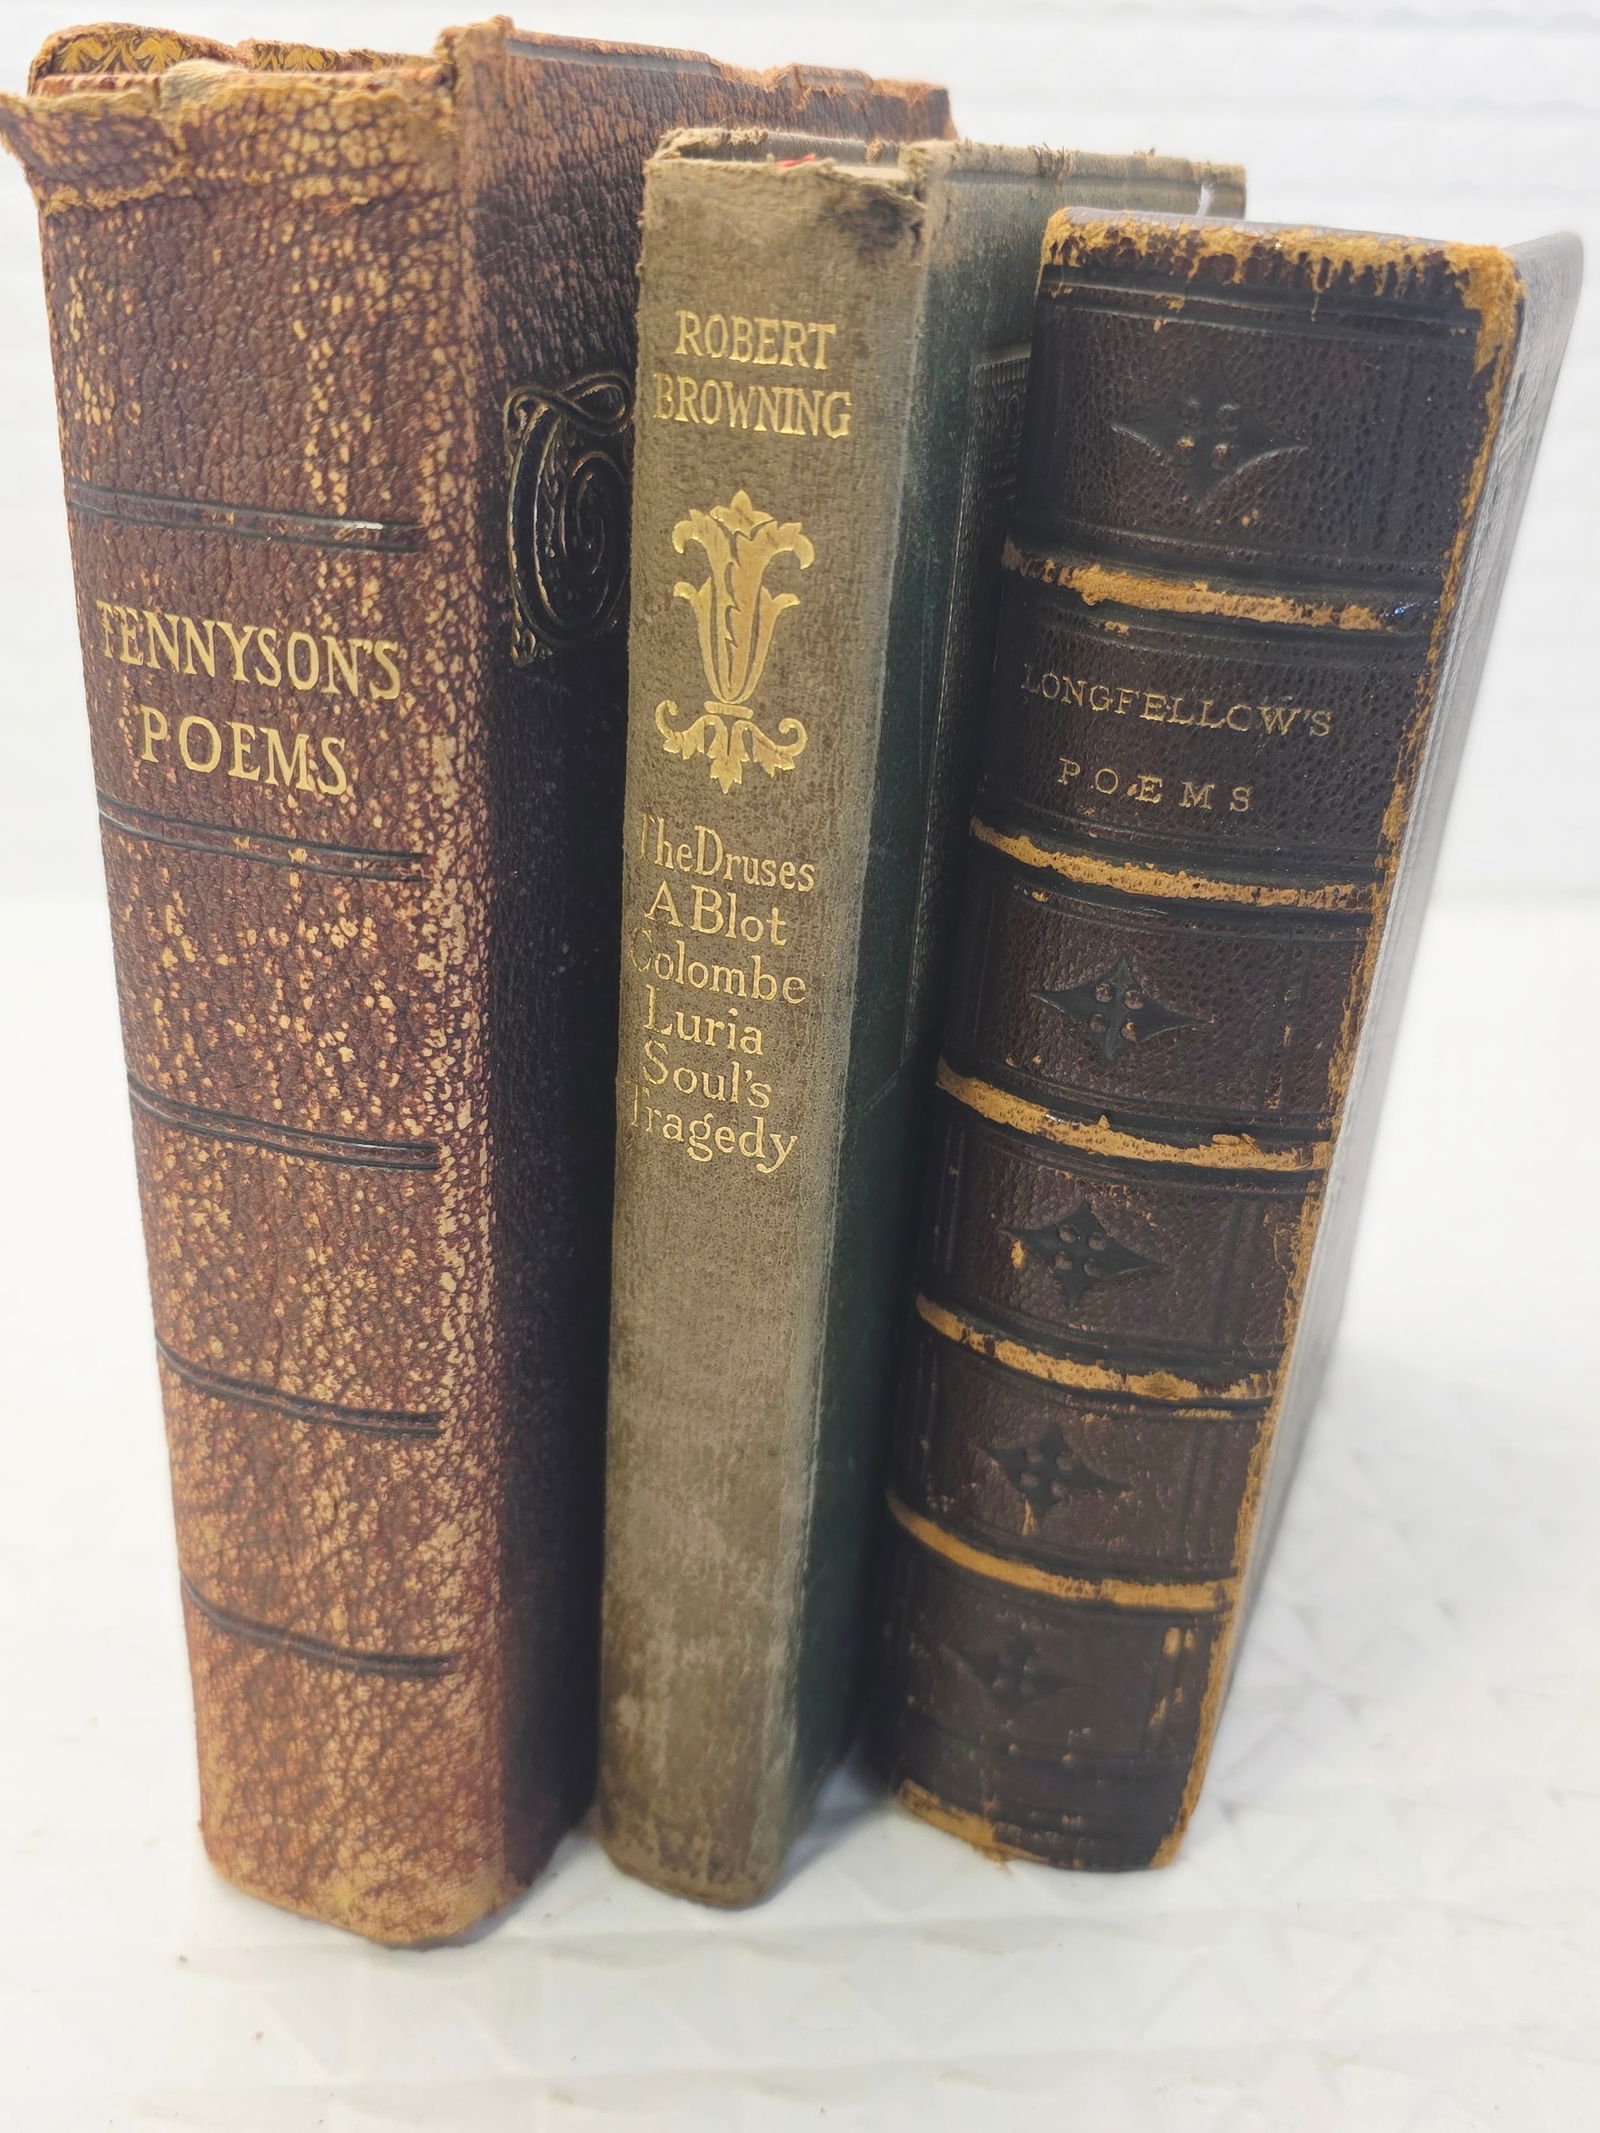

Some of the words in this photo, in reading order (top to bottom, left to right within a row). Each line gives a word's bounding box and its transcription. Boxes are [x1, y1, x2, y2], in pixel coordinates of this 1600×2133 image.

[674, 309, 837, 370] ROBERT
[653, 371, 853, 440] BROWNING
[96, 600, 401, 700] TENNYSON'S
[138, 704, 347, 795] POEMS
[1057, 756, 1252, 812] POEMS
[644, 880, 684, 927] A
[690, 884, 788, 946] Blot
[643, 983, 764, 1055] Luria
[642, 1039, 773, 1109] Soul's
[624, 1079, 799, 1174] Tragedy
